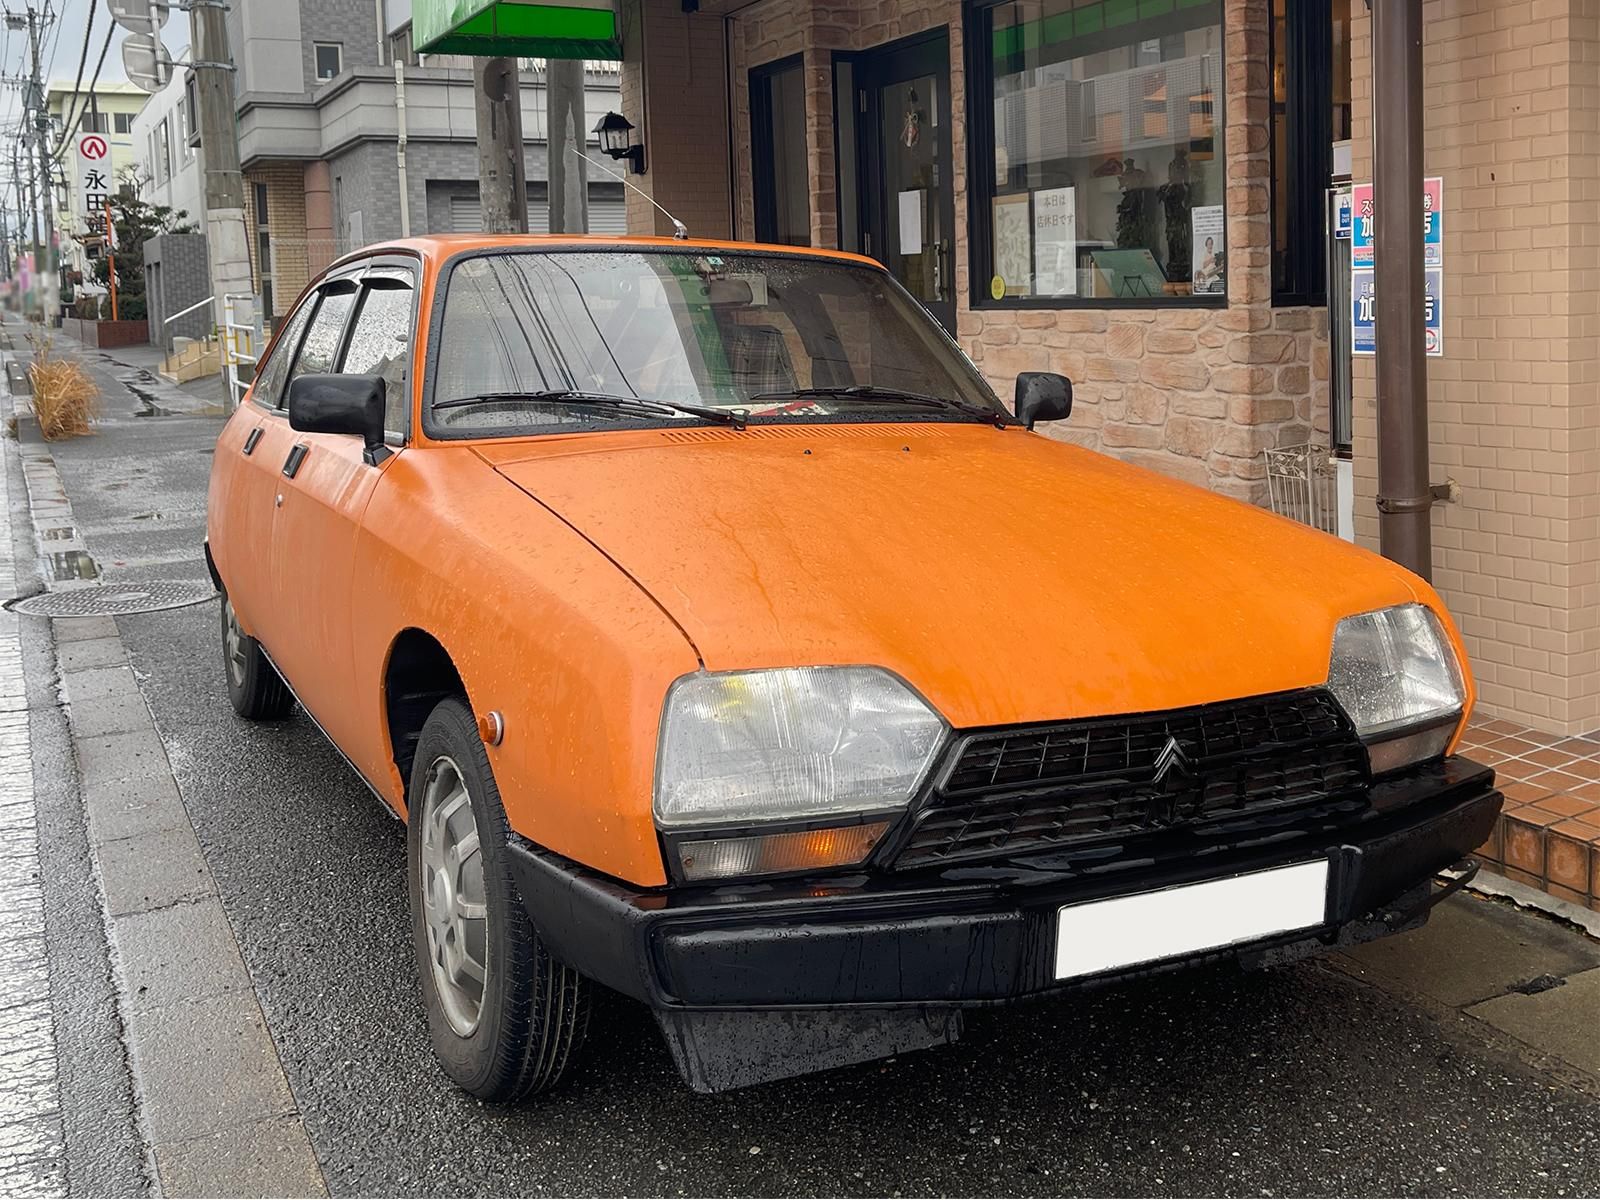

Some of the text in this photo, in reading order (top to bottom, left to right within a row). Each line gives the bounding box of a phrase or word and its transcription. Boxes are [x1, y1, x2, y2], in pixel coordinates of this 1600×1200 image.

[1043, 194, 1066, 207] 本日は
[1037, 214, 1074, 228] 店休日です
